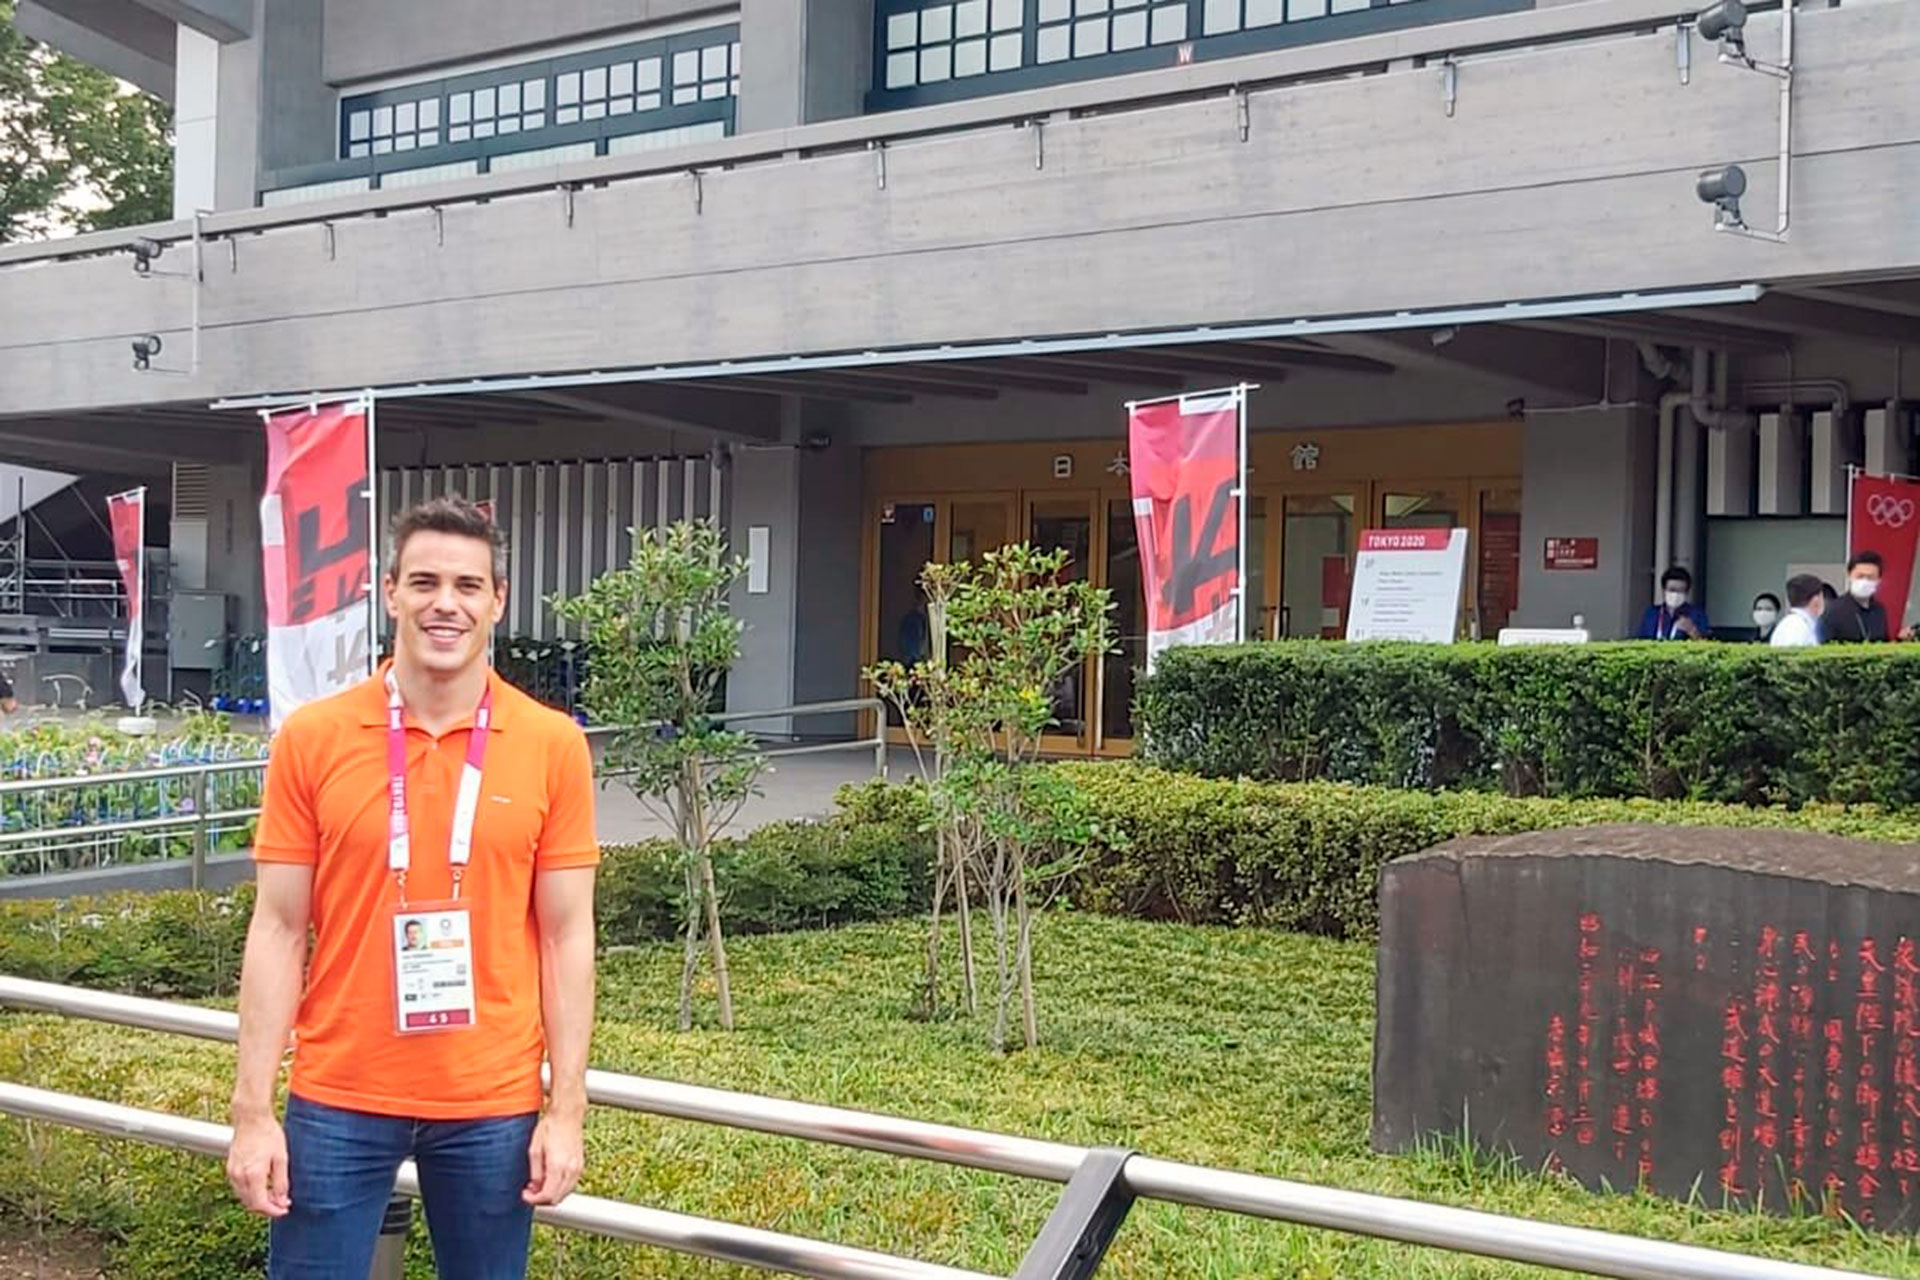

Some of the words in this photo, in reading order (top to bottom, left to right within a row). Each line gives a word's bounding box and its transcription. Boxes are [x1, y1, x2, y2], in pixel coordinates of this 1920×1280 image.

[1178, 44, 1193, 63] W
[1368, 535, 1399, 548] TOKYO
[1400, 534, 1426, 548] 2020
